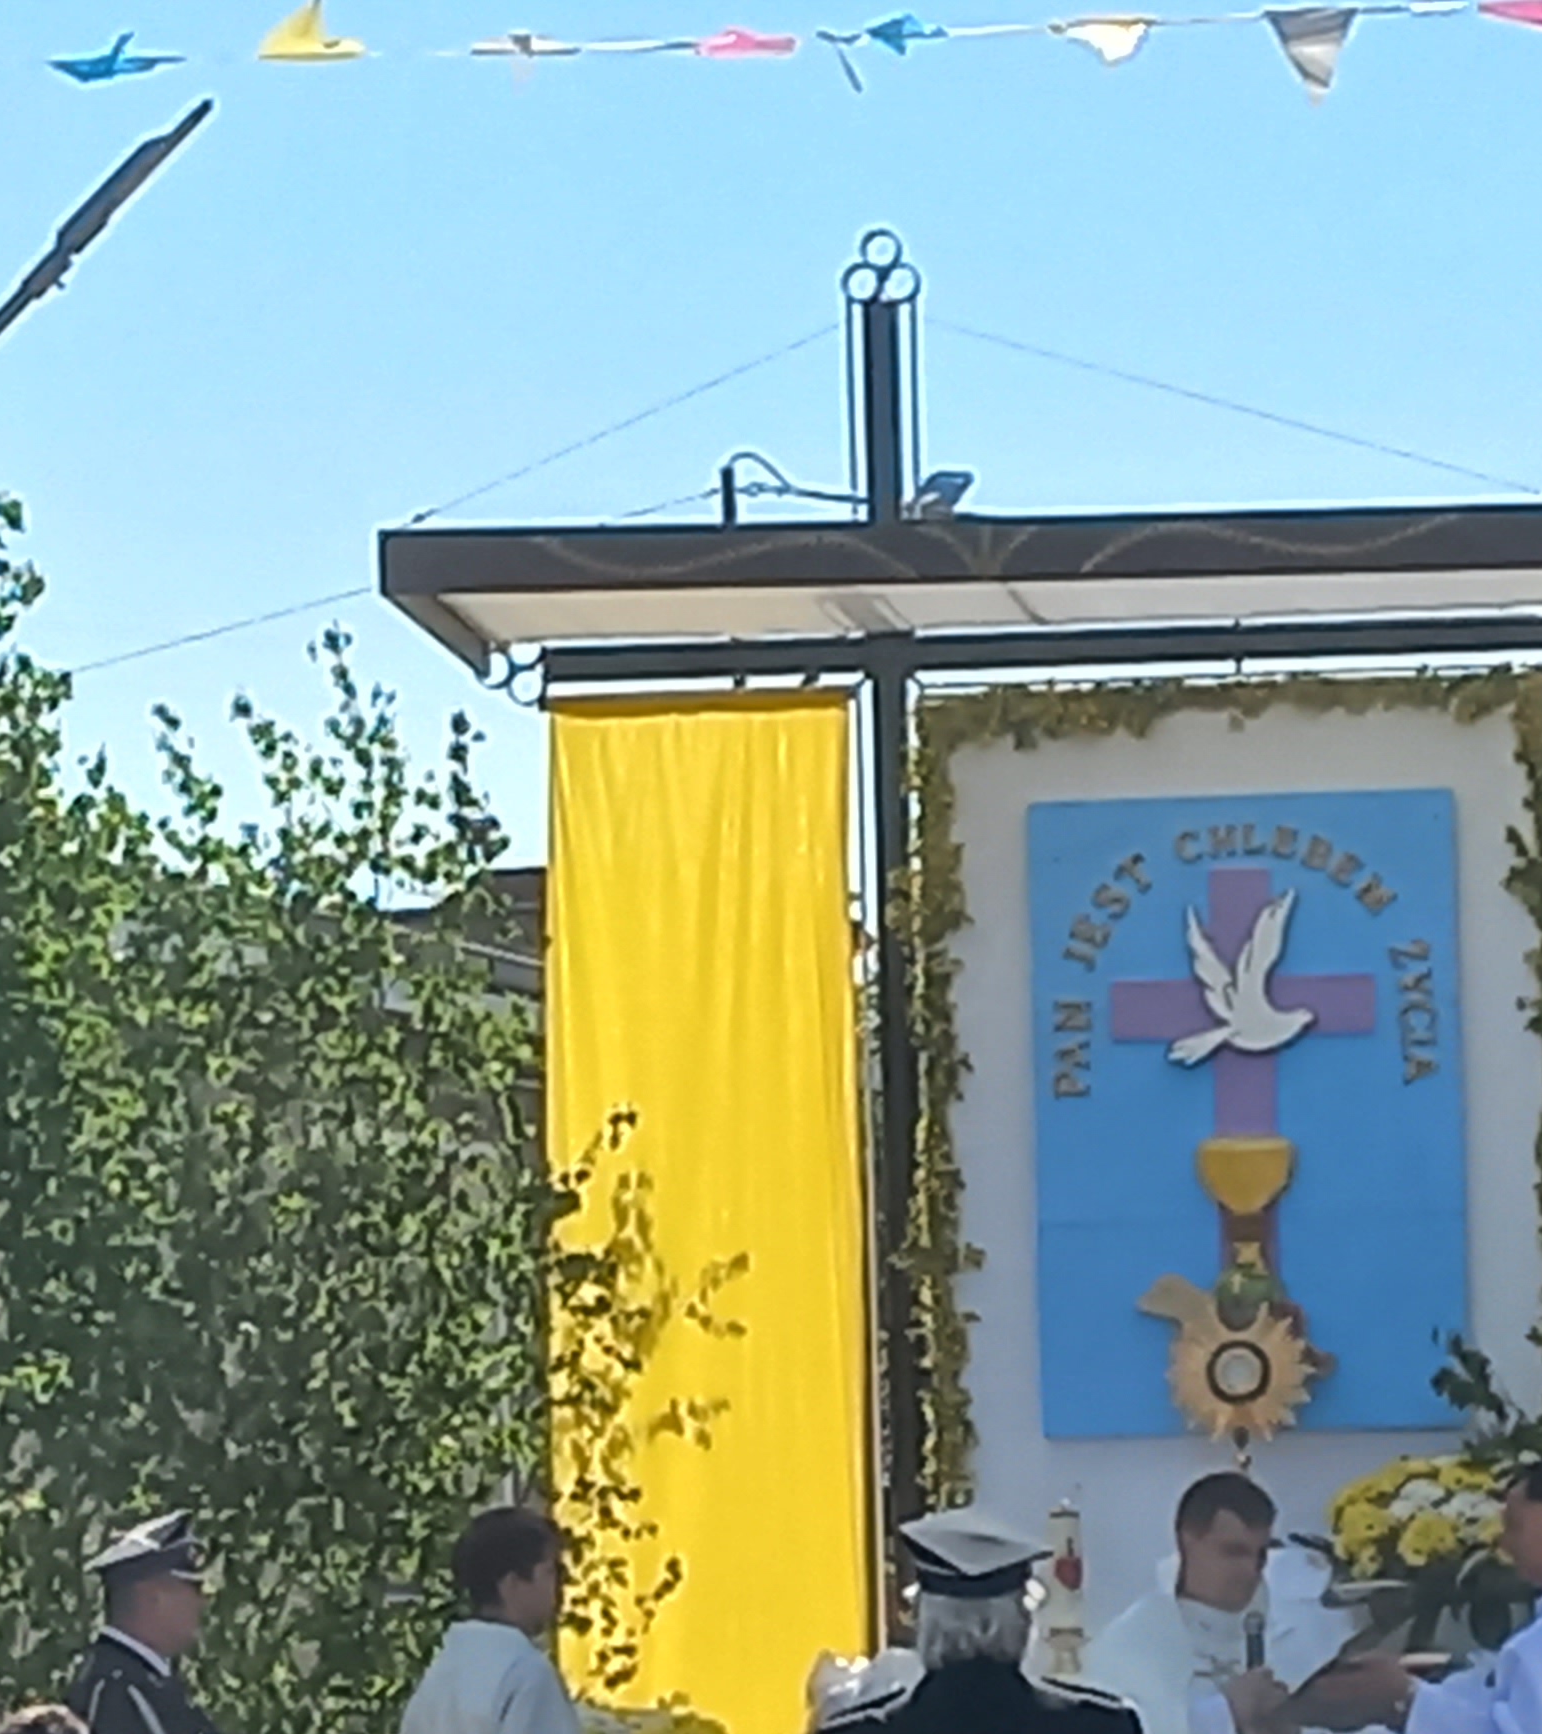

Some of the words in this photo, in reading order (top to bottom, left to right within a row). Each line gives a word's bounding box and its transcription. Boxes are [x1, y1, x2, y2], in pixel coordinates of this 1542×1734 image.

[1061, 853, 1154, 973] JEST
[1174, 823, 1398, 917] CHLEBEM
[1054, 999, 1093, 1099] PAN
